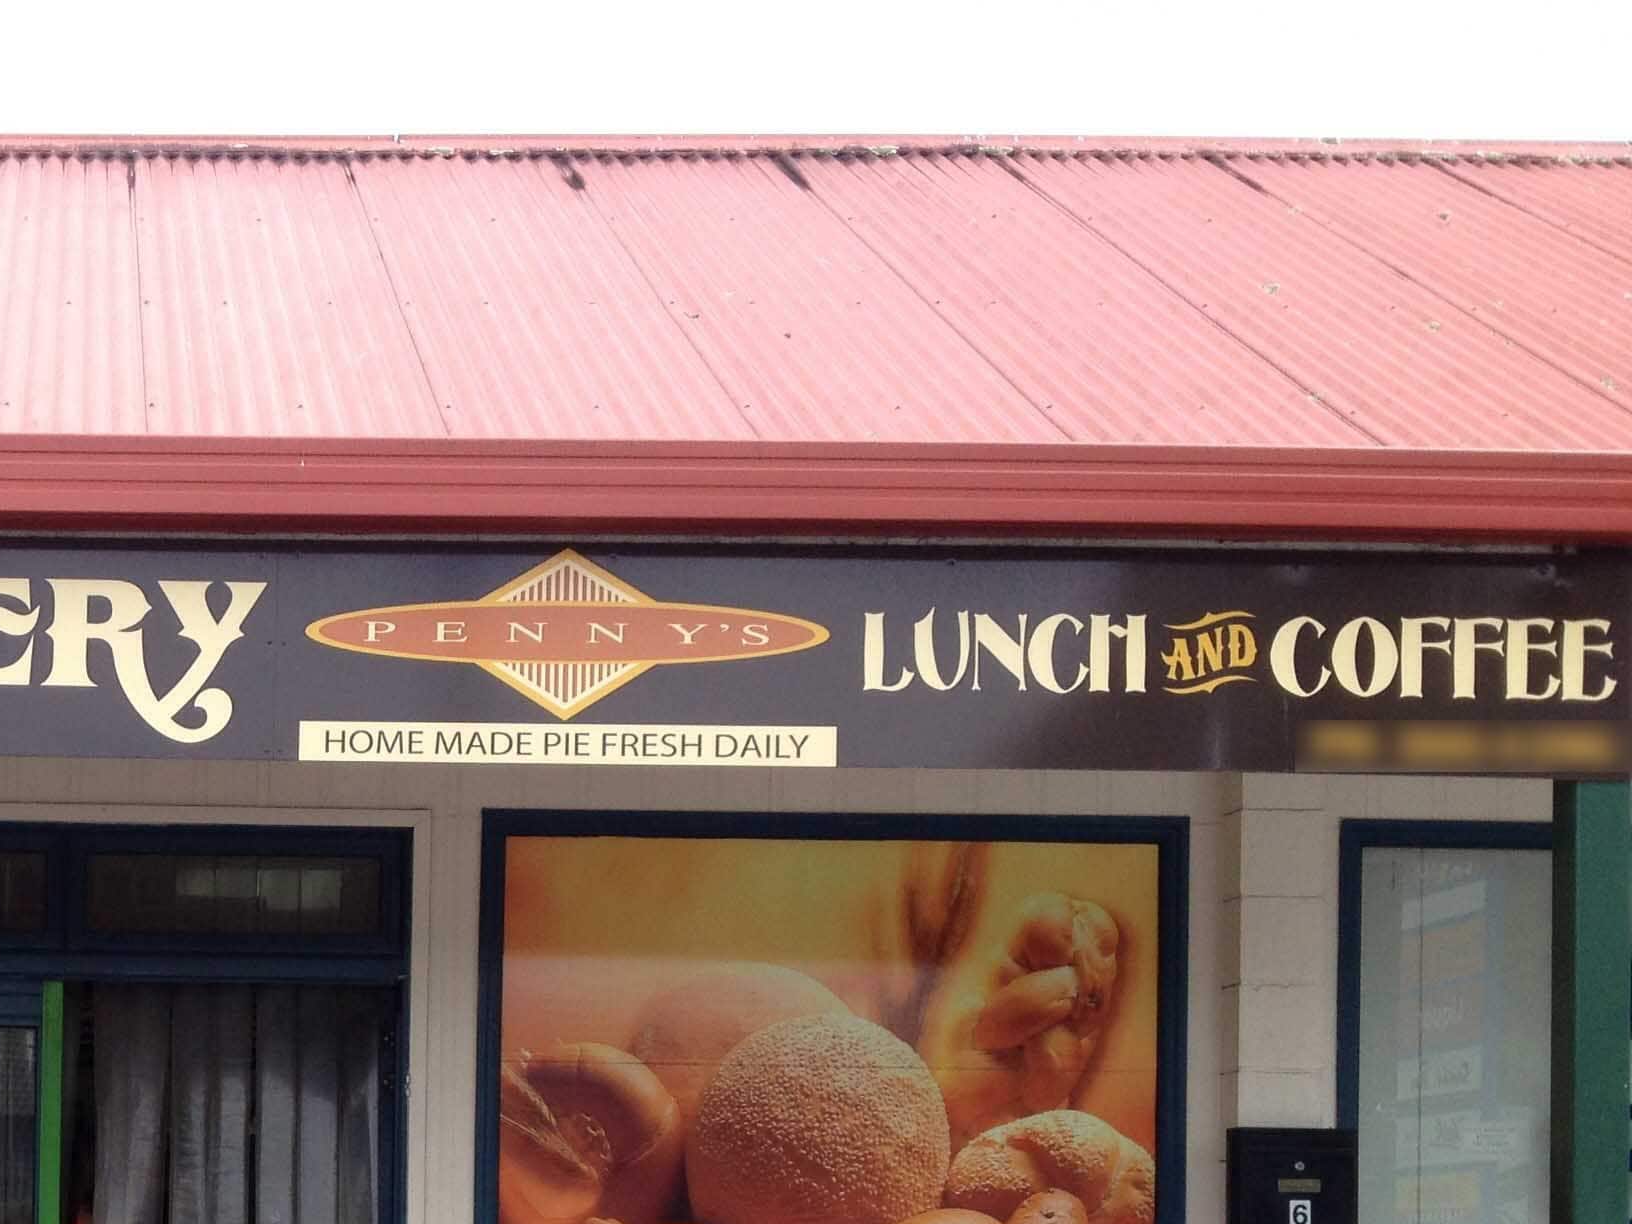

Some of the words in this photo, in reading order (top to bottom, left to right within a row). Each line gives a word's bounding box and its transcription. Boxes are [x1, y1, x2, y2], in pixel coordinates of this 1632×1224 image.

[362, 619, 771, 647] PENNY'S
[862, 606, 1146, 694] LUNCH
[1161, 622, 1259, 682] AND
[1270, 614, 1617, 702] COFFEE
[324, 729, 424, 755] HOME
[435, 731, 533, 756] MADE
[543, 732, 590, 757] PIE
[601, 733, 703, 758] FRESH
[714, 734, 809, 760] DAILY
